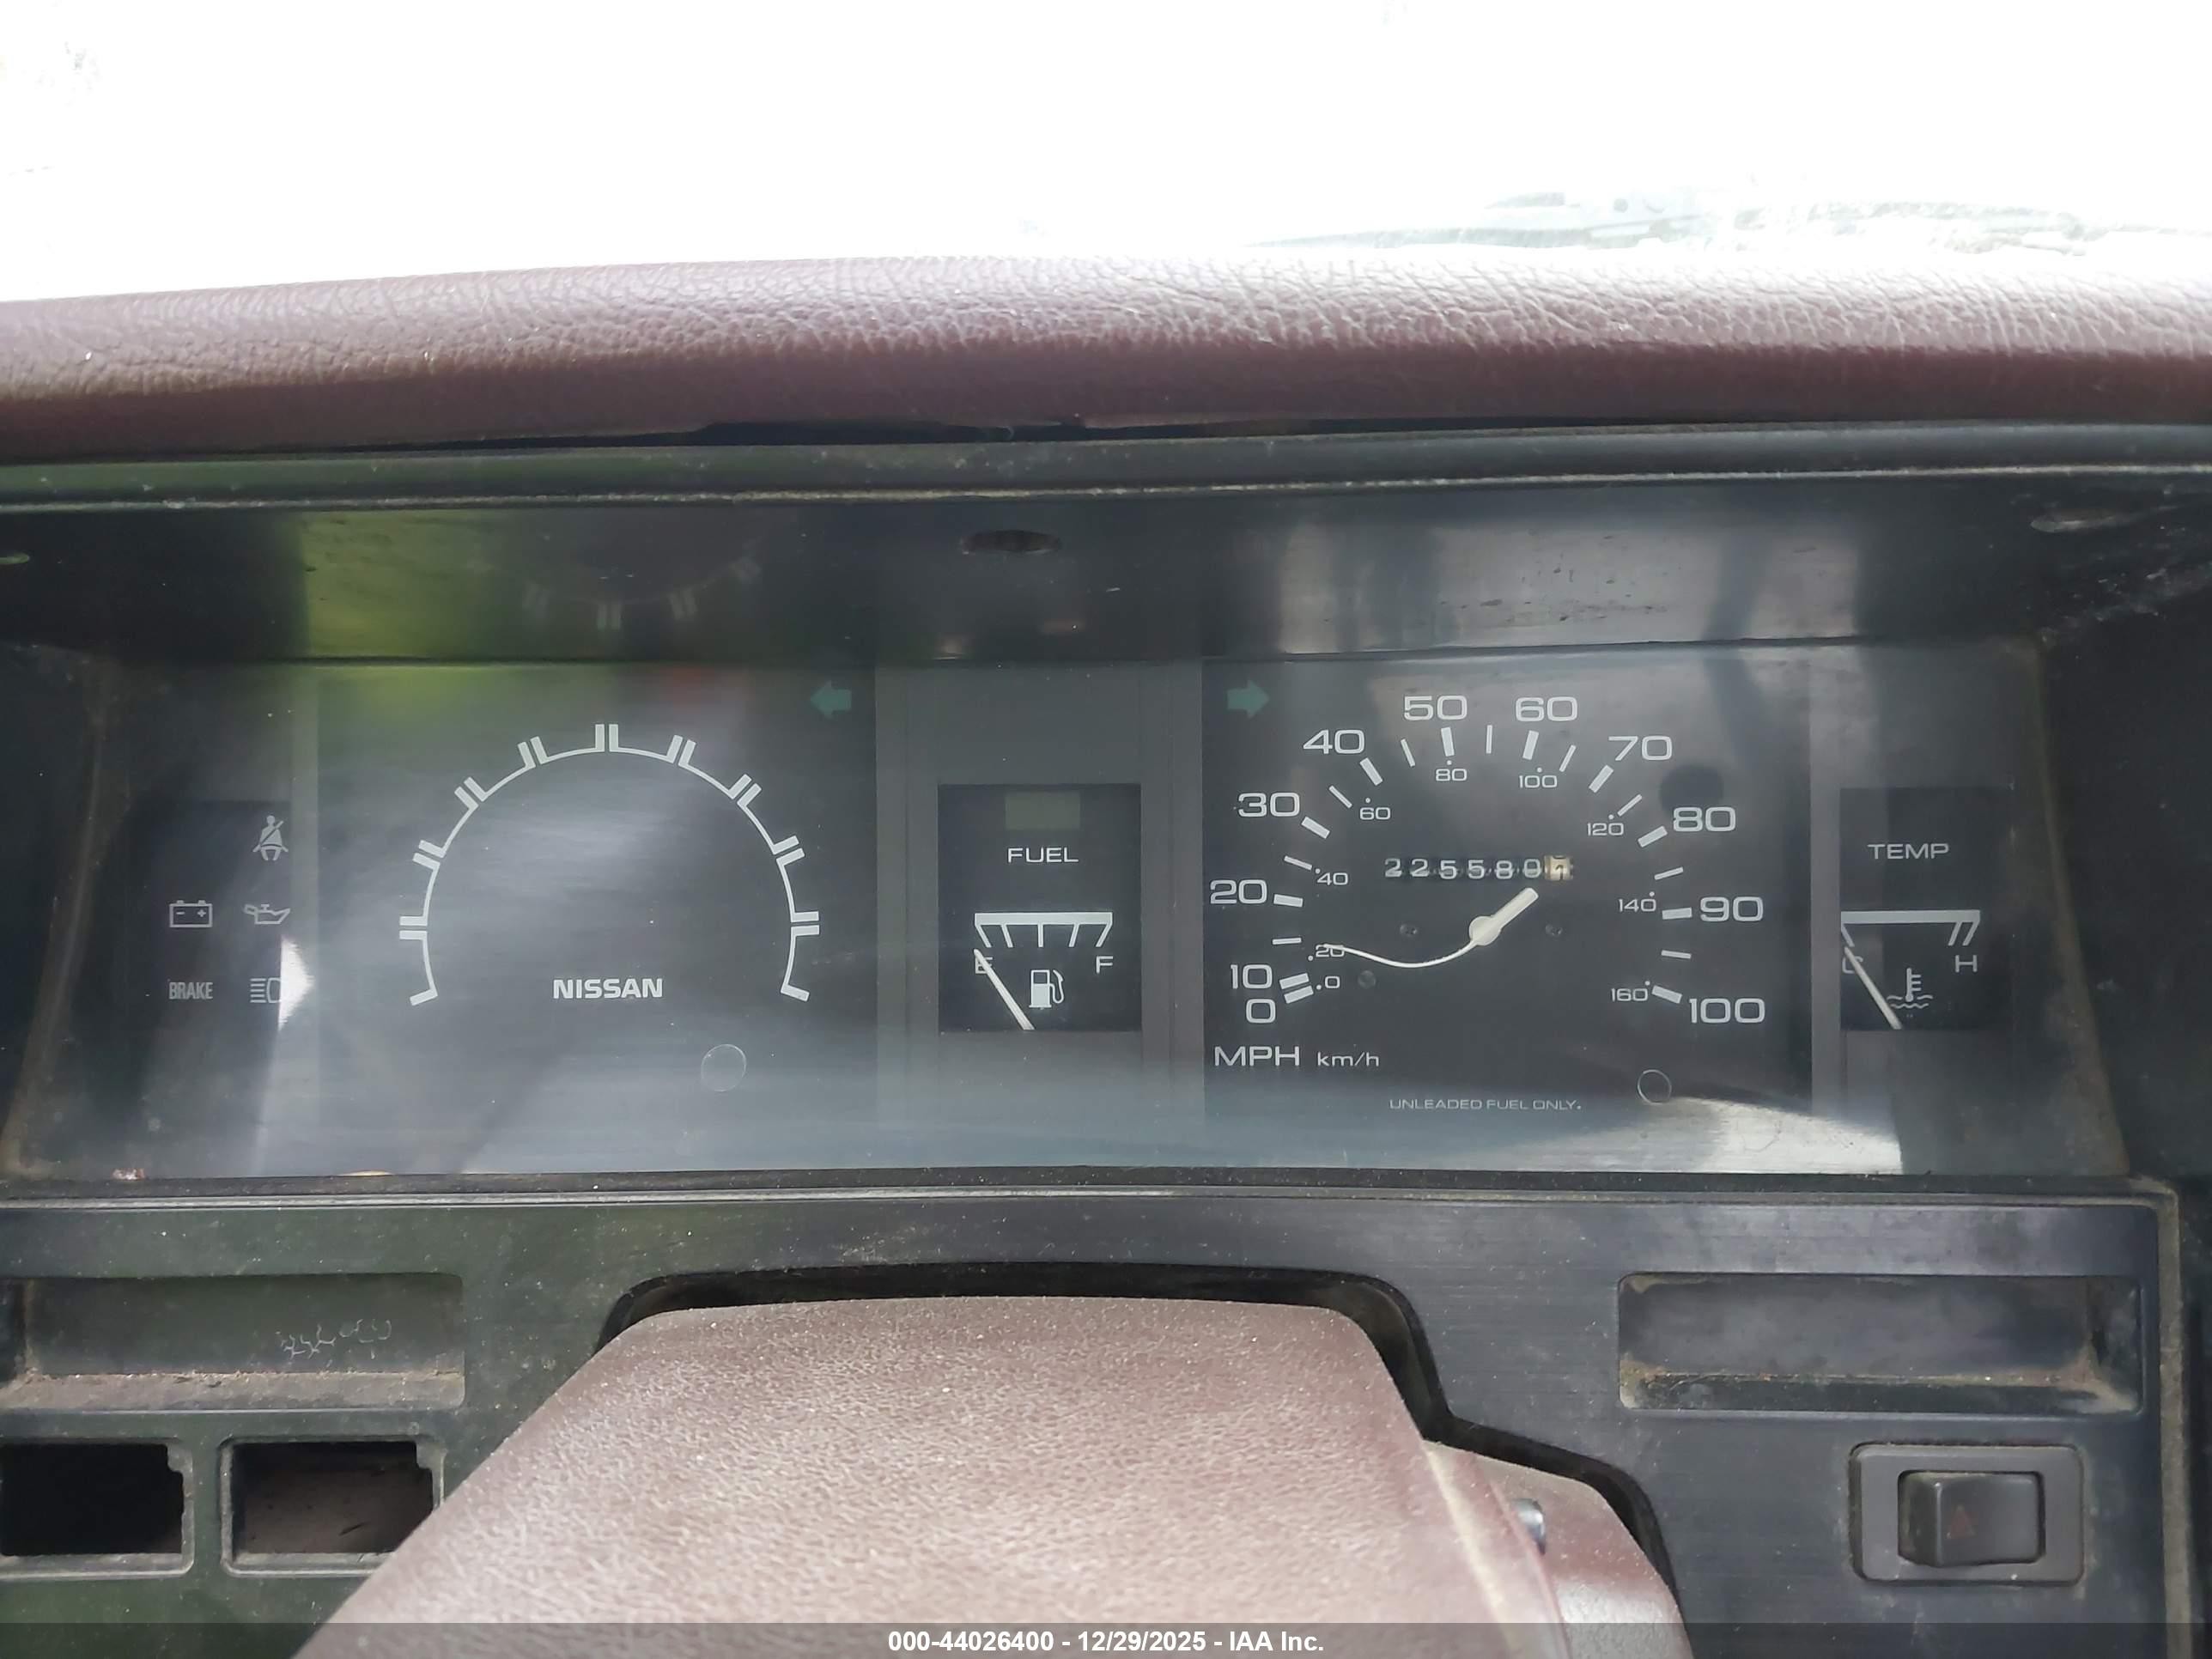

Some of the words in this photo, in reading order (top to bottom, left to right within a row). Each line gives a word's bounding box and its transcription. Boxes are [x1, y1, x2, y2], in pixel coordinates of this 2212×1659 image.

[1403, 695, 1468, 720] 50
[1515, 696, 1578, 722] 60
[1303, 729, 1365, 754] 40
[1608, 735, 1673, 762] 70
[1435, 768, 1468, 781] 80
[1518, 775, 1558, 789] 100
[1237, 792, 1300, 817] 30
[1359, 807, 1392, 820] 60
[1673, 806, 1736, 832] 80
[1587, 822, 1625, 836] 120
[1007, 846, 1079, 863] FUEL
[1867, 843, 1949, 860] TEMP
[1316, 872, 1349, 885] 40
[1210, 878, 1268, 904] 20
[1618, 897, 1657, 912] 140
[1699, 896, 1764, 922] 90
[1315, 945, 1346, 958] 20
[1096, 956, 1114, 974] F
[1954, 955, 1978, 973] H
[1230, 963, 1273, 989] 10
[1324, 975, 1340, 989] 0
[169, 981, 214, 1000] BRAKE
[552, 977, 664, 1000] NISSAN
[1611, 988, 1649, 1002] 160
[1245, 998, 1276, 1024] 0
[1689, 998, 1765, 1024] 100
[1214, 1045, 1301, 1066] MPH
[1316, 1051, 1380, 1067] km/h
[1389, 1098, 1483, 1110] UNLEADED
[1486, 1098, 1528, 1110] FUEL
[1532, 1099, 1582, 1110] ONLY.
